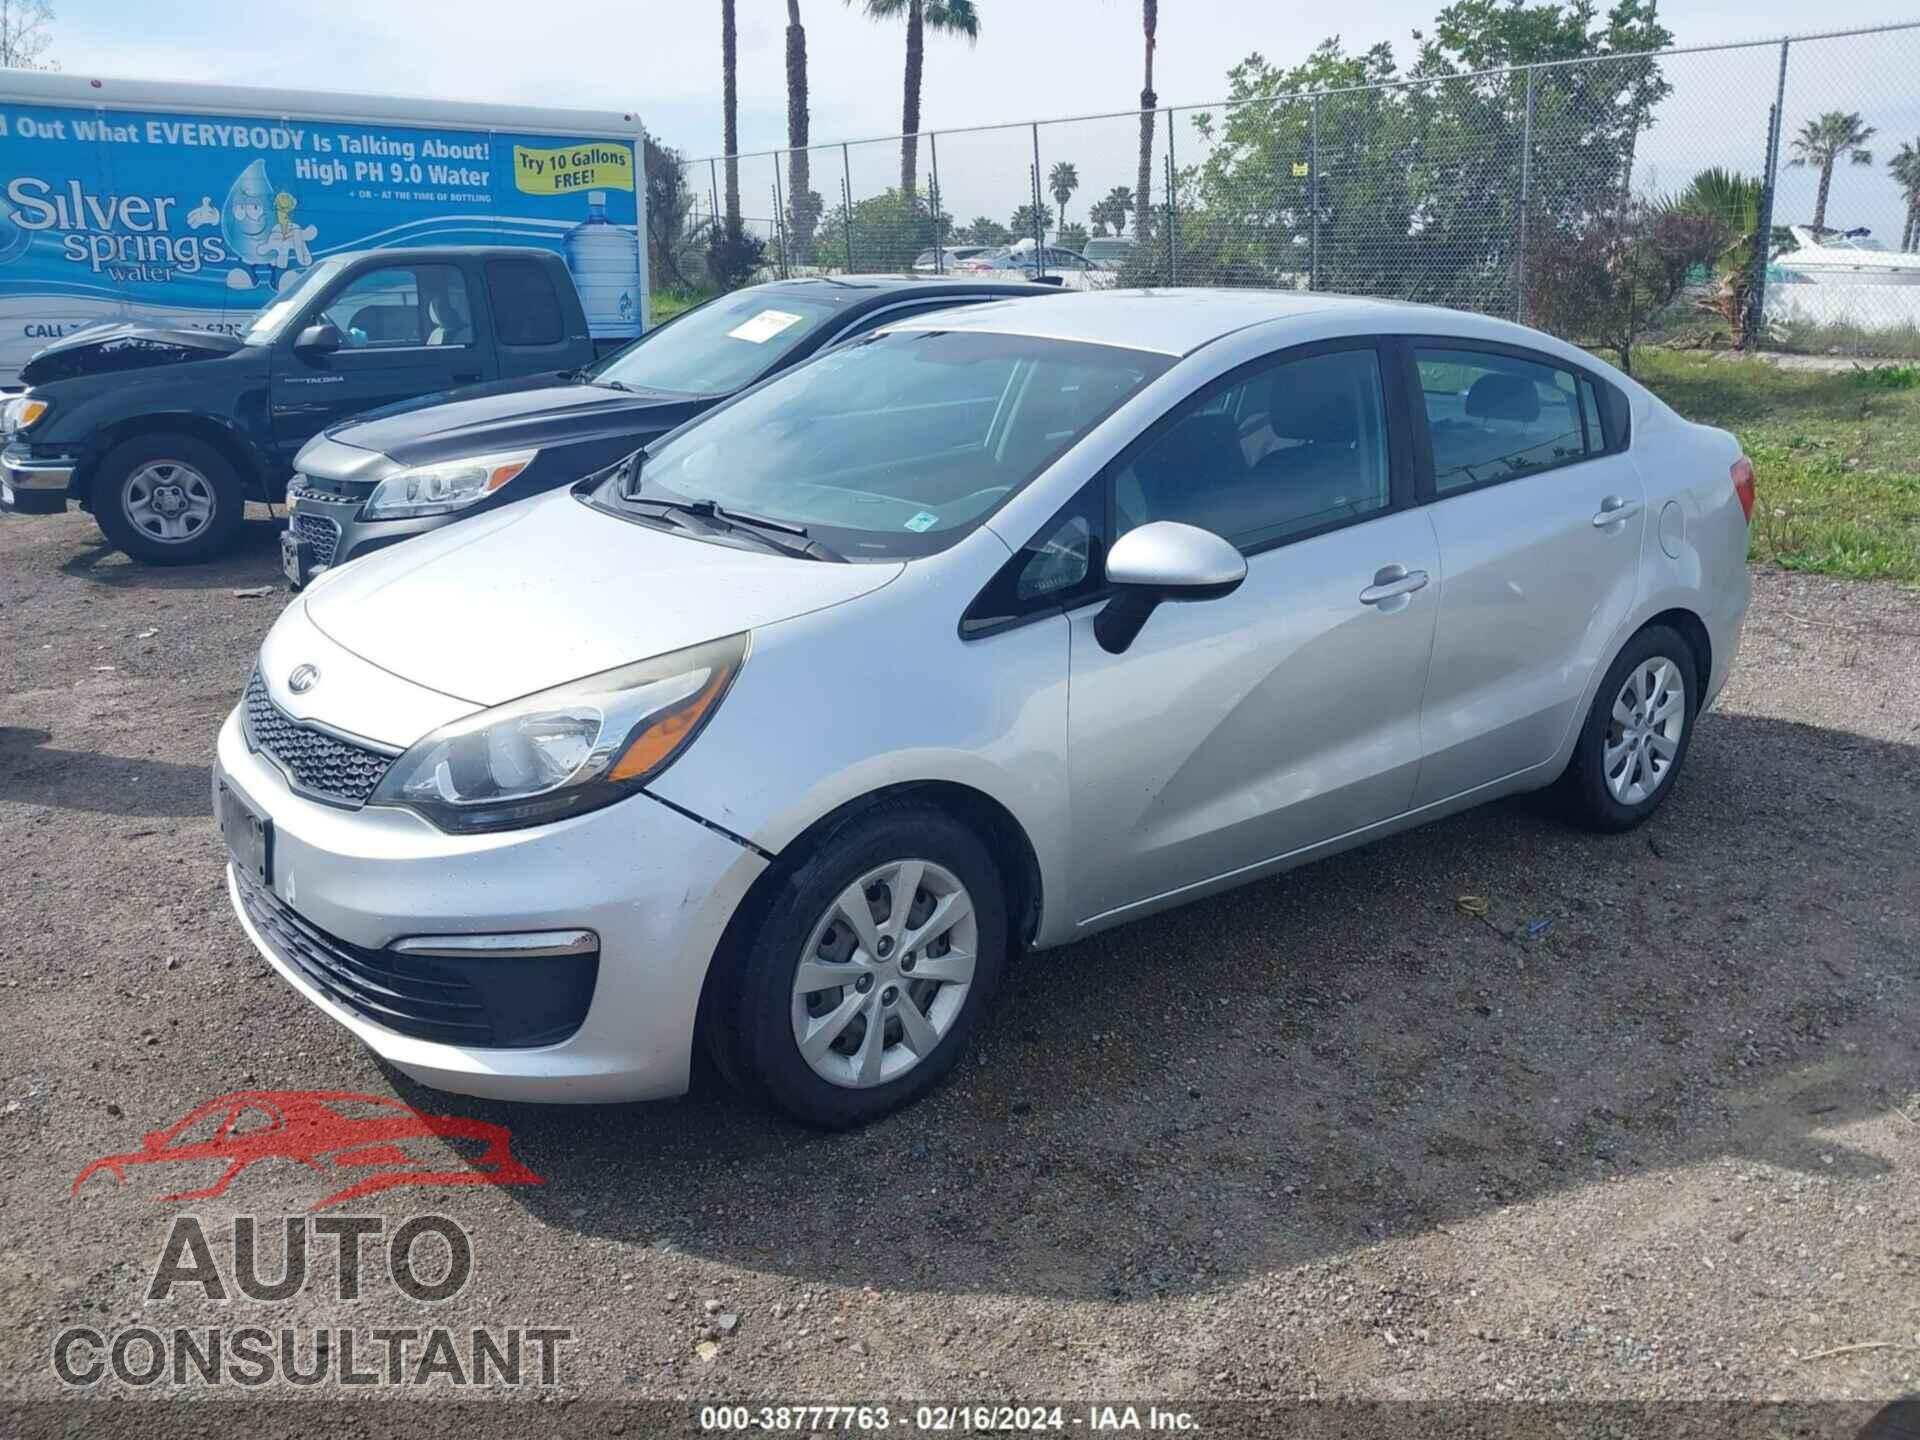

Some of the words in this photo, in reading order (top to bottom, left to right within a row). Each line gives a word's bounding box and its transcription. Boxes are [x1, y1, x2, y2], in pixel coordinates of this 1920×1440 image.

[16, 117, 65, 140] Out
[72, 119, 139, 143] What
[146, 121, 304, 151] EVERYBODY
[312, 133, 332, 152] Is
[338, 134, 415, 162] Talking
[422, 139, 490, 160] About!
[295, 157, 348, 186] High
[355, 160, 384, 183] PH
[391, 163, 422, 184] 9.0
[428, 164, 490, 186] Water
[519, 152, 544, 175] Try
[550, 155, 567, 171] 10
[571, 148, 627, 167] Gallons
[554, 169, 595, 189] FREE!
[7, 177, 176, 231] Silver
[394, 191, 410, 200] THE
[63, 233, 226, 273] springs
[108, 264, 174, 281] water
[24, 324, 64, 338] CALL
